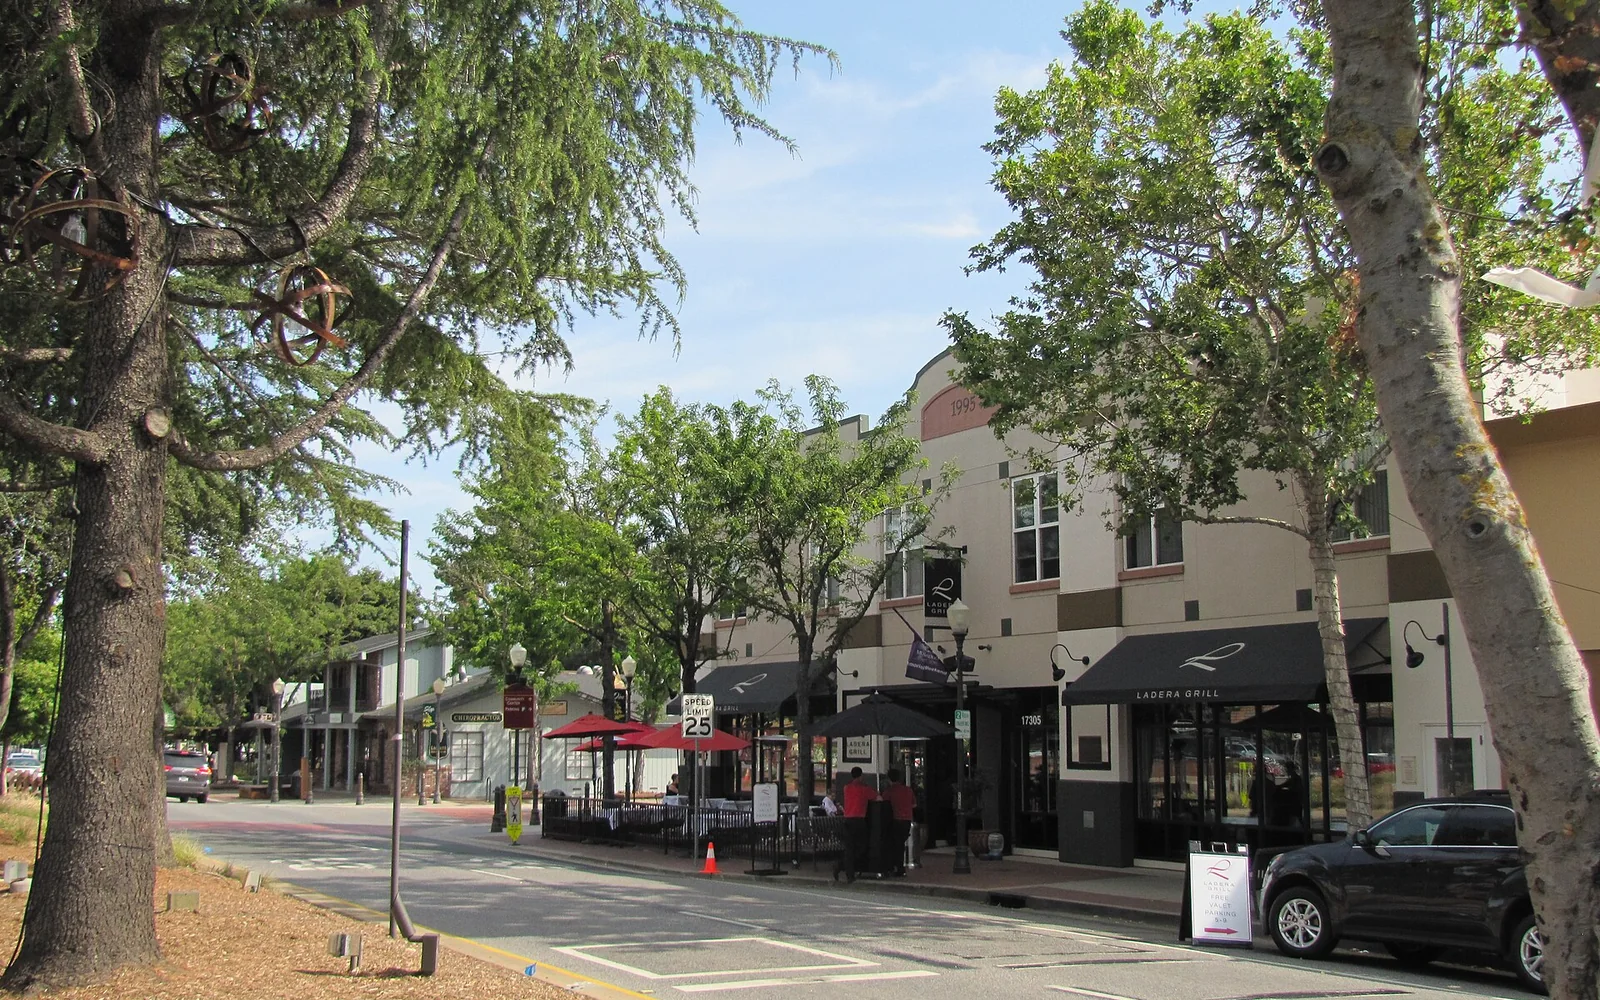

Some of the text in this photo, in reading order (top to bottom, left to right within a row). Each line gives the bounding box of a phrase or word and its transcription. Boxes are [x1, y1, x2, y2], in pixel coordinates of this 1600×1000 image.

[950, 396, 976, 417] 1995
[1136, 689, 1219, 699] LADERA GRILL
[684, 698, 712, 706] SPEED
[686, 708, 709, 716] LIMIT
[1021, 715, 1042, 726] 17305
[685, 716, 711, 736] 25
